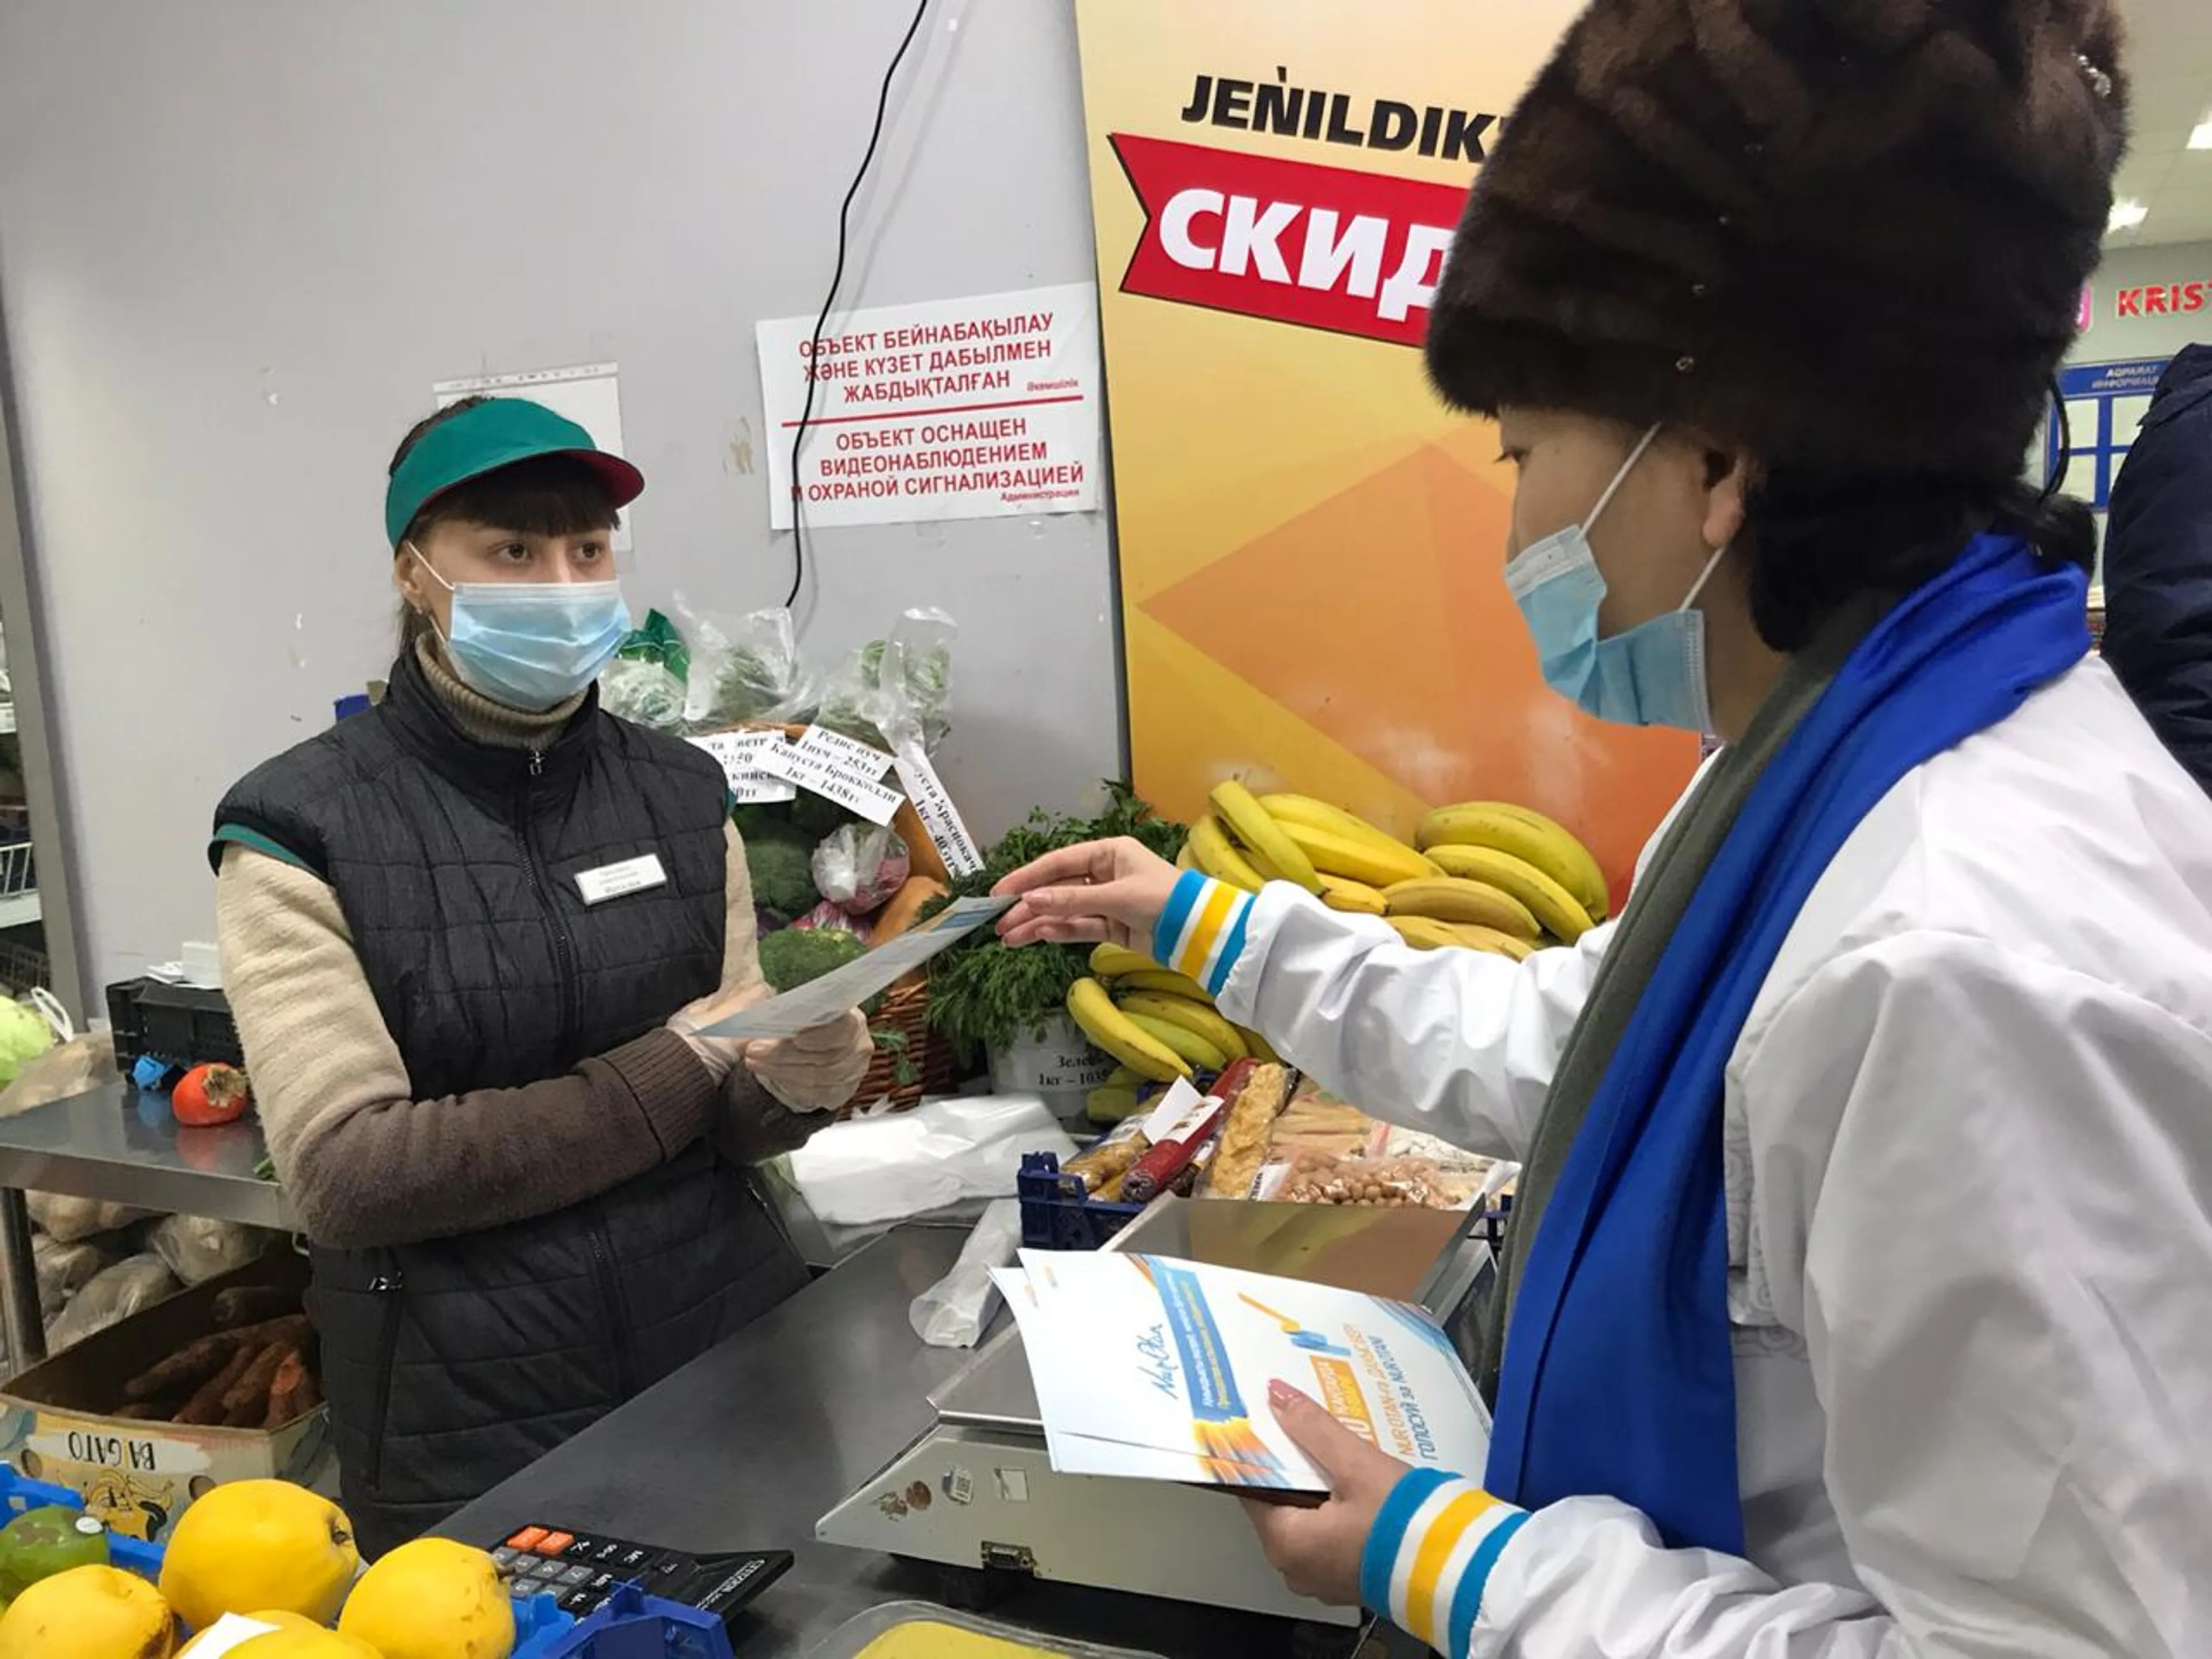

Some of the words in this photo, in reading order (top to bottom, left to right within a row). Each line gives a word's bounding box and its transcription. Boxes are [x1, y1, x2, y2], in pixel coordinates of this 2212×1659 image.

[2119, 282, 2212, 316] KRIS
[800, 334, 877, 358] ОБЪЕКТ
[884, 313, 1053, 349] БЕЙНАБАҚЫЛАУ
[804, 359, 859, 382] ЖӘНЕ
[865, 353, 922, 376] КҮЗЕТ
[929, 339, 1051, 371] ДАБЫЛМЕН
[844, 369, 1010, 403] ЖАБДЫҚТАЛҒАН
[836, 427, 915, 450] ОБЪЕКТ
[922, 418, 1026, 446] ОСНАЩЕН
[820, 442, 1047, 477] ВИДЕОНАБЛЮДЕНИЕМ
[809, 475, 899, 501] ОХРАНОЙ
[905, 461, 1083, 495] СИГНАЛИЗАЦИЕЙ
